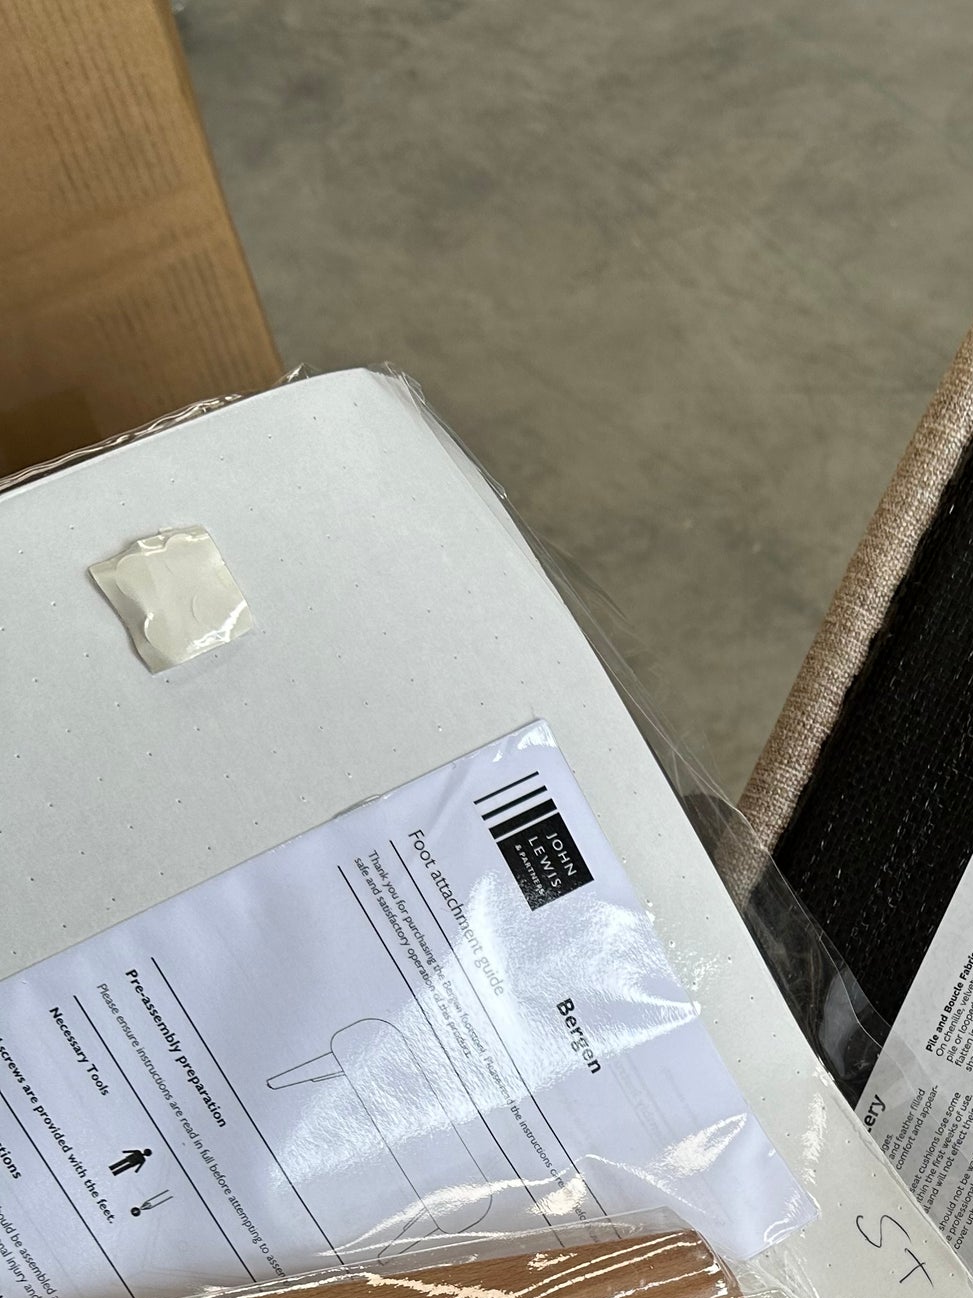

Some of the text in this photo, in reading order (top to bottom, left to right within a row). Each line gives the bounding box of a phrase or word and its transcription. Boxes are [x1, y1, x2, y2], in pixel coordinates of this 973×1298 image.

[514, 844, 523, 852] &
[528, 835, 562, 888] LEWIS
[545, 832, 578, 877] JOHN
[353, 857, 436, 993] safe and satisfactory operation
[368, 849, 438, 966] Thank you for purchasing
[407, 828, 504, 997] Foot attachment guide
[48, 1006, 110, 1097] Necessary Tools
[124, 968, 227, 1128] Pre-assembly preparation
[555, 997, 602, 1075] Bergen
[925, 1034, 940, 1053] Pile
[935, 1013, 949, 1034] and
[943, 981, 964, 1014] Boucle
[935, 1042, 948, 1057] On
[943, 1007, 966, 1043] chenille,
[21, 1084, 39, 1105] are
[32, 1104, 74, 1154] provided
[67, 1153, 88, 1179] with
[83, 1178, 100, 1199] the
[95, 1198, 116, 1225] feet.
[96, 983, 270, 1255] Please ensure instructions are read in full before attempting to
